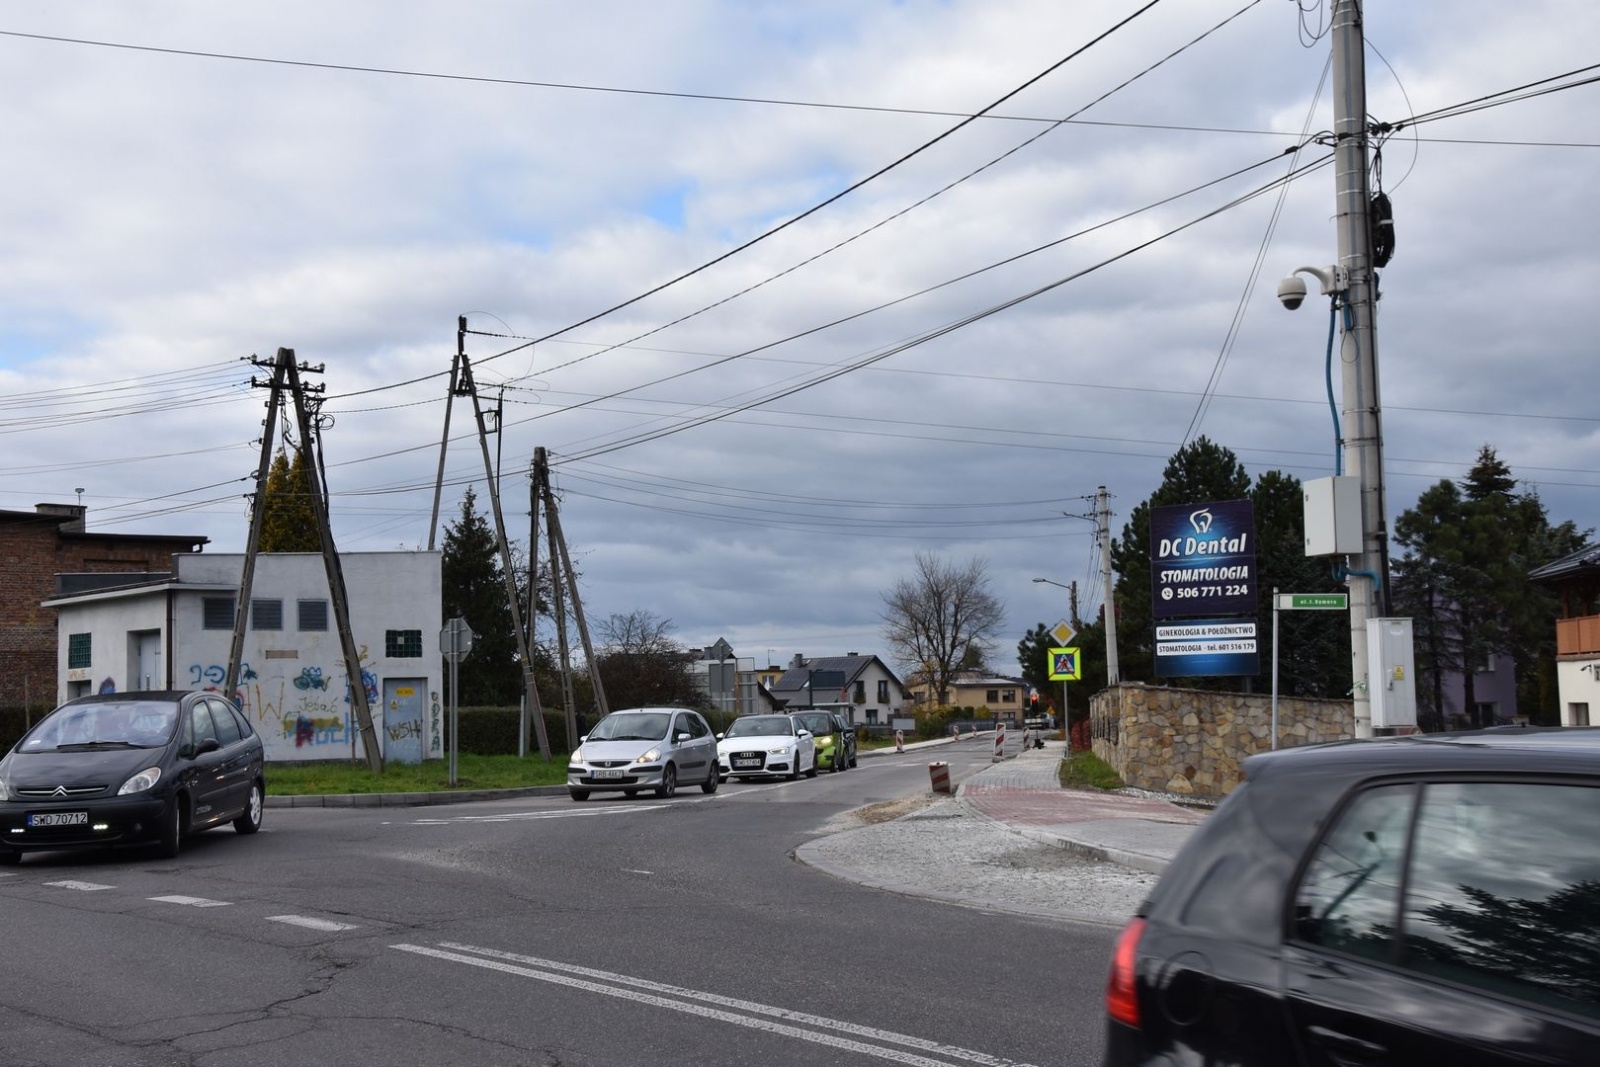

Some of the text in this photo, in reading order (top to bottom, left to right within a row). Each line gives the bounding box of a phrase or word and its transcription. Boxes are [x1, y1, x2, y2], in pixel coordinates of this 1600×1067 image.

[1159, 533, 1247, 557] DC Dental
[1160, 566, 1249, 584] STOMATOLOGIA
[1177, 585, 1248, 598] 506 771 224
[1159, 628, 1200, 637] GINEKOLOGIA
[1208, 626, 1254, 635] POŁOŻNICTWO
[1159, 645, 1202, 653] STOMATOLOGIA
[1219, 643, 1229, 651] 601
[33, 813, 87, 826] SWD 70712
